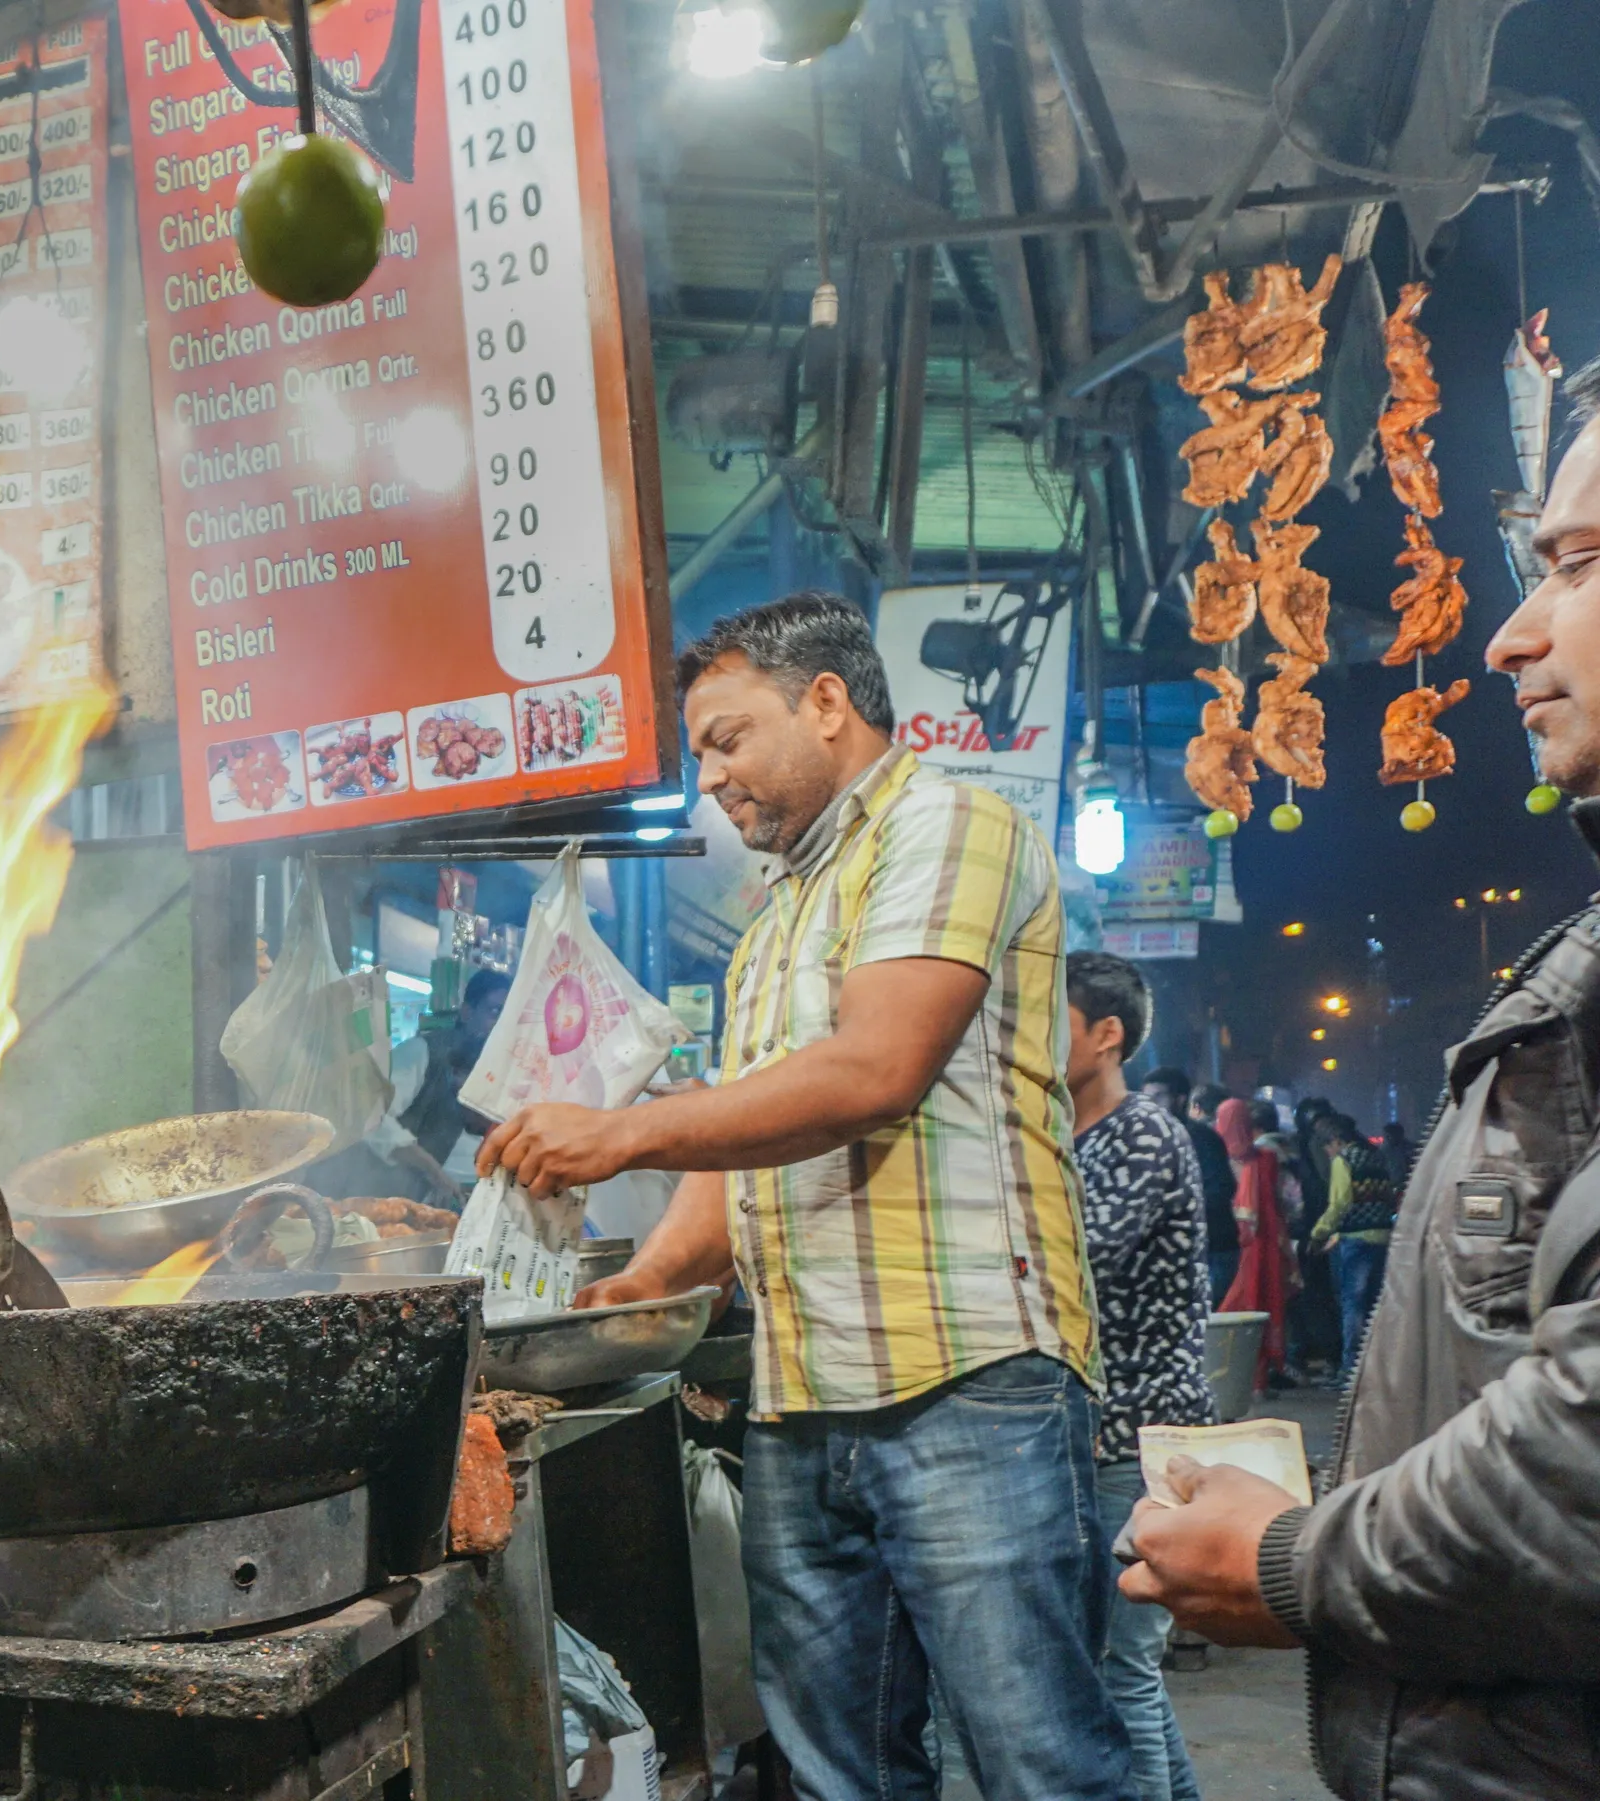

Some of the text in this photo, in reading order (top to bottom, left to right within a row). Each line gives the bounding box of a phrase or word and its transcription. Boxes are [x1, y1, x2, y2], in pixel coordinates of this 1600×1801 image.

[144, 29, 192, 77] Full
[455, 0, 527, 43] 400
[150, 83, 246, 136] Singara
[457, 58, 528, 106] 100
[43, 174, 89, 201] 320/-
[154, 141, 251, 195] Singara
[460, 119, 536, 168] 120
[159, 182, 542, 253] Chicke 160
[469, 241, 549, 293] 320
[169, 289, 527, 372] Chicken Qorma Full 80
[173, 381, 277, 427] Chicken
[283, 359, 370, 404] Qorma
[481, 371, 556, 418] 360
[180, 441, 282, 490] Chicken
[185, 500, 287, 549] Chicken
[292, 482, 362, 525] Tikka
[489, 446, 538, 487] 90
[190, 502, 540, 607] Cold Drinks 300 ML 20
[195, 559, 543, 668] Bisleri 20
[201, 615, 547, 726] Roti 4
